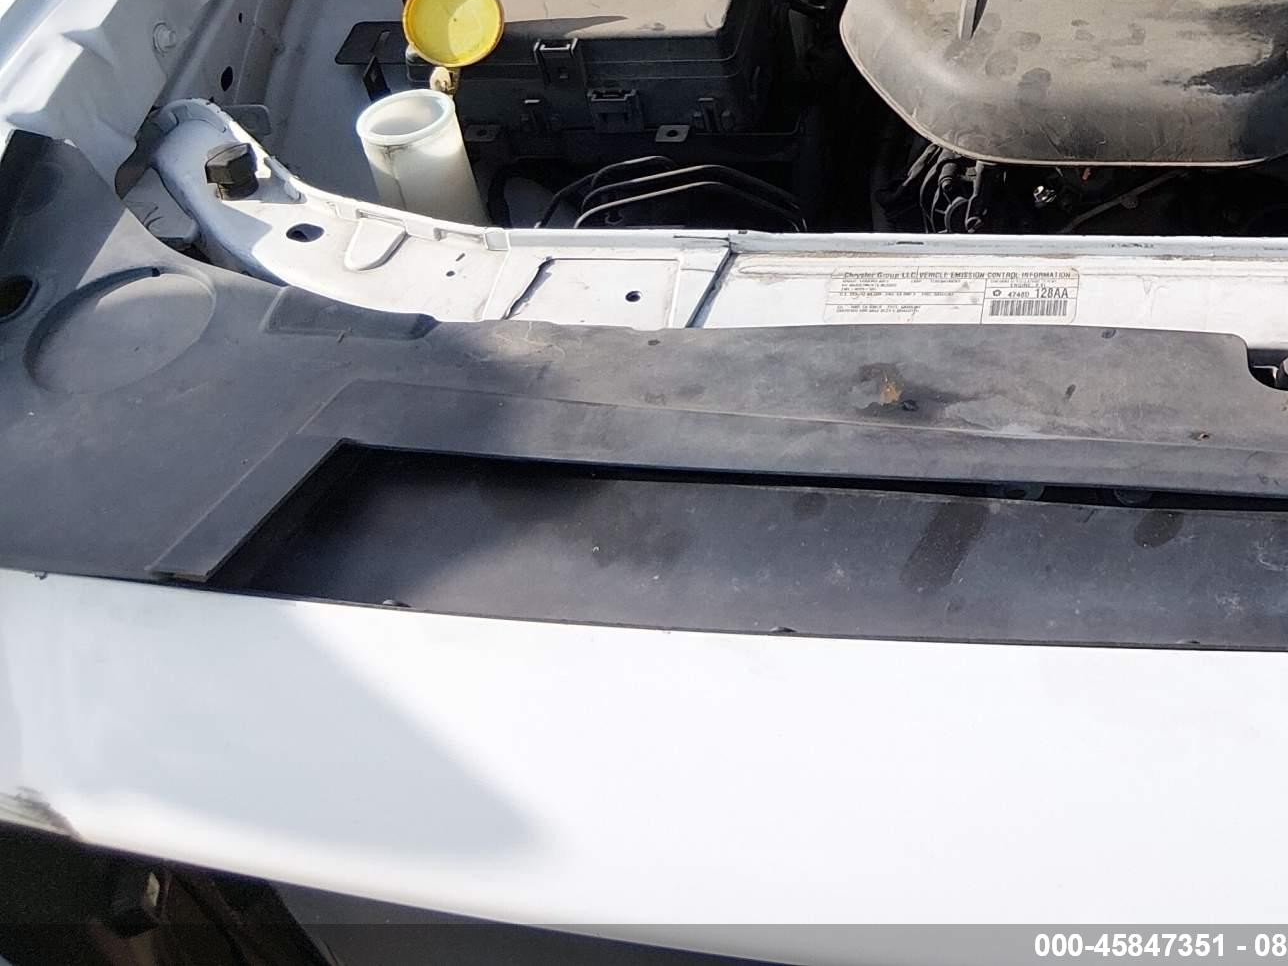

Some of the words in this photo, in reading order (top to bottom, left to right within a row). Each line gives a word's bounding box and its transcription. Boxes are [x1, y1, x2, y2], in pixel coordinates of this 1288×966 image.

[844, 271, 875, 280] Chrysler
[877, 271, 900, 280] Group
[950, 271, 985, 279] EMISSION
[987, 271, 1018, 279] CONTROL
[1021, 271, 1071, 279] INFORMATION
[1035, 287, 1069, 299] 128AA
